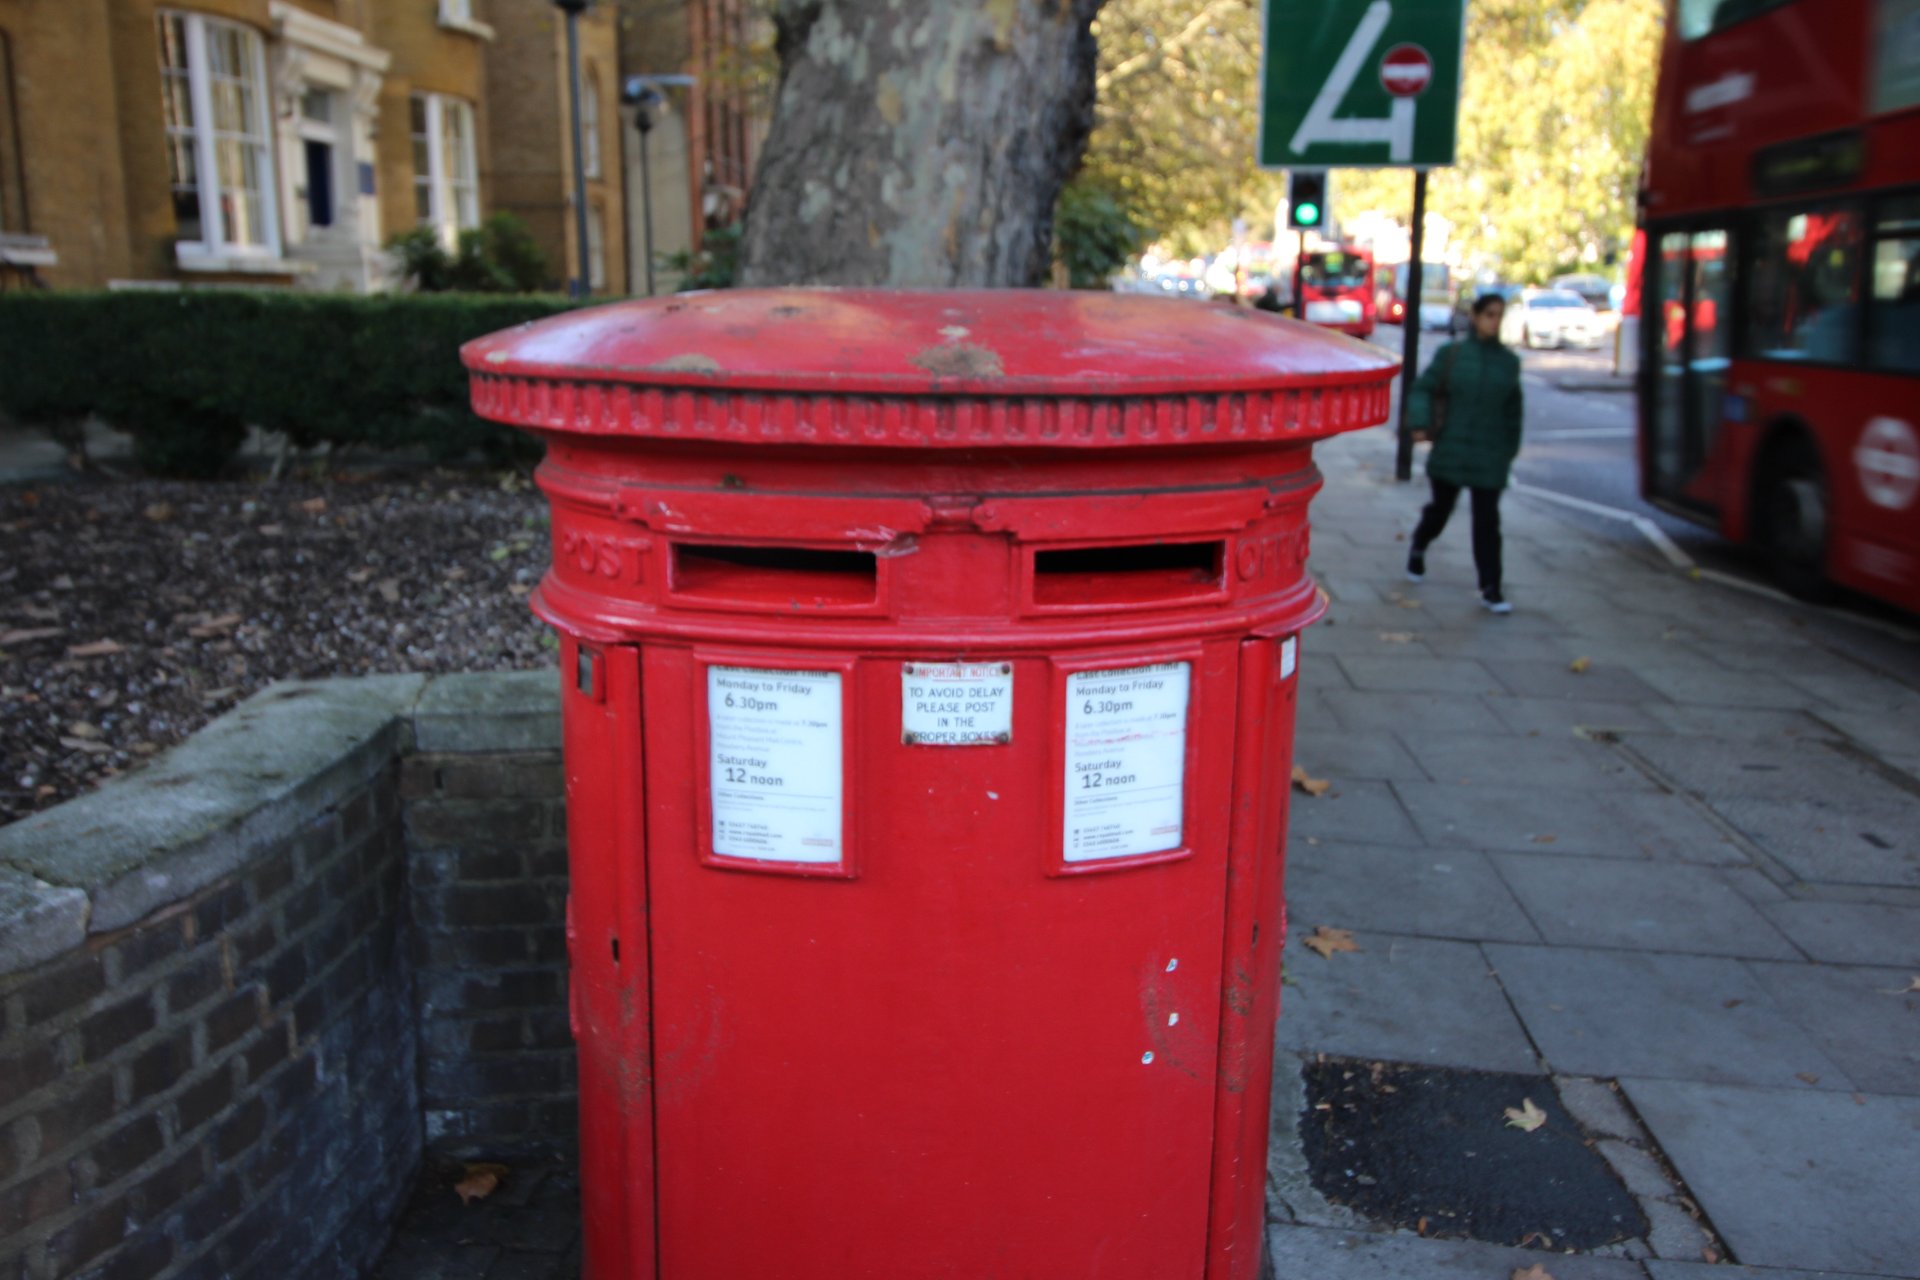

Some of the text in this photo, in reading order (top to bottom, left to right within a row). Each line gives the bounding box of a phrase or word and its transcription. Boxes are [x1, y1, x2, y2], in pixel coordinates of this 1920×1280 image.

[563, 526, 651, 584] POST
[916, 667, 966, 678] IMPORTANT
[716, 678, 812, 695] Monday to Friday
[909, 687, 1004, 698] TO AVOID DELAY
[1076, 678, 1164, 697] Monday to Friday
[724, 691, 778, 711] 6.30pm
[916, 702, 995, 713] PLEASE POST
[1083, 699, 1134, 715] 6.30pm
[937, 716, 975, 727] IN THE
[912, 731, 956, 742] PROPER
[717, 754, 768, 769] Saturday
[1075, 759, 1122, 773] Saturday
[725, 767, 783, 787] 12 noon
[1082, 772, 1136, 789] 12 noon
